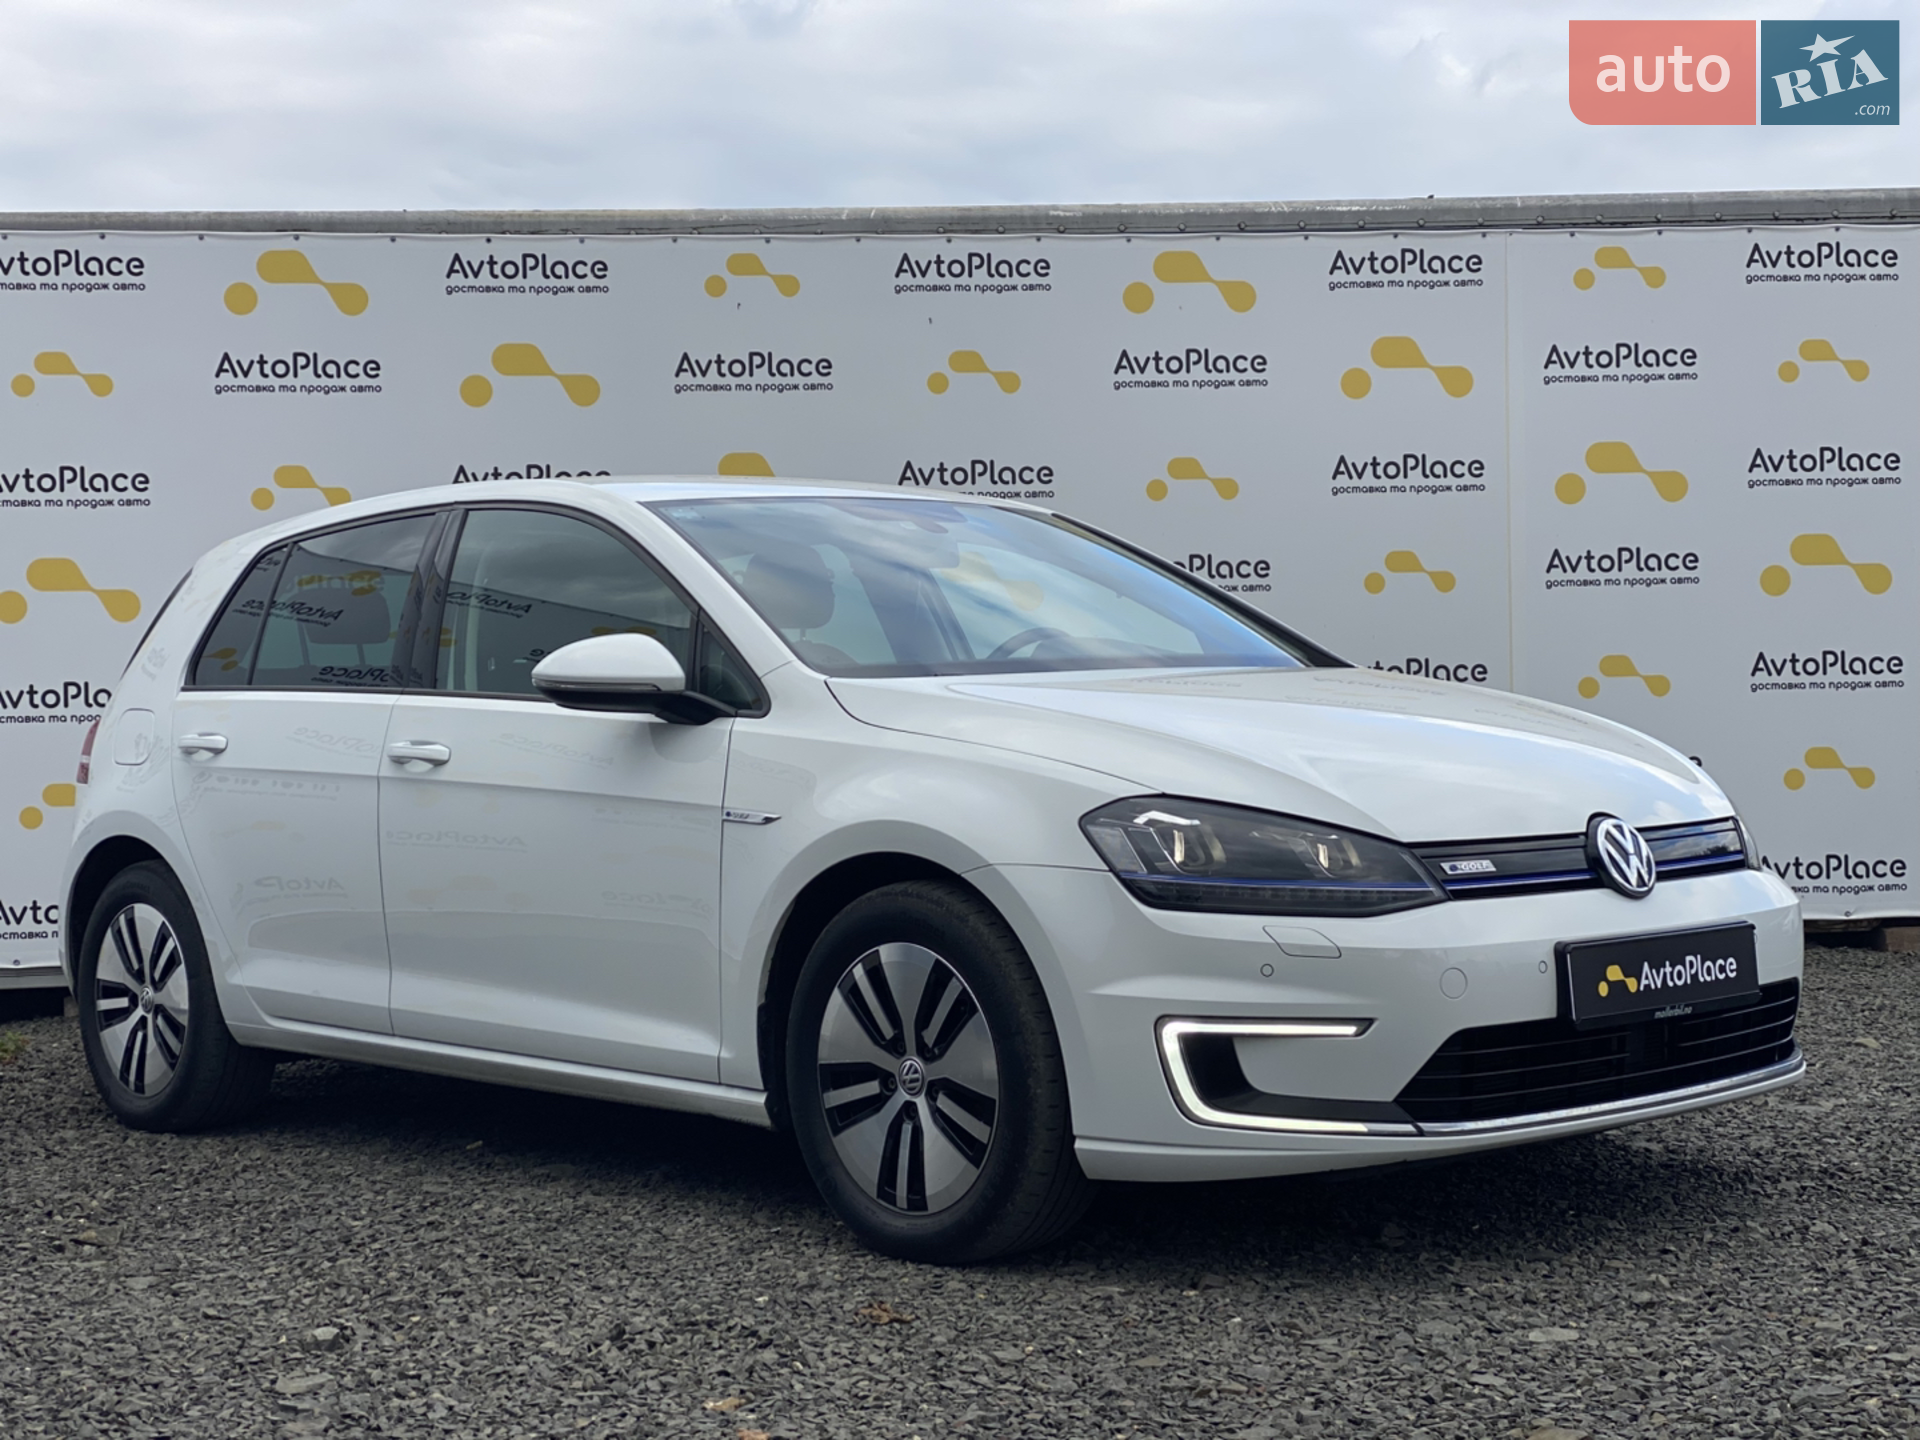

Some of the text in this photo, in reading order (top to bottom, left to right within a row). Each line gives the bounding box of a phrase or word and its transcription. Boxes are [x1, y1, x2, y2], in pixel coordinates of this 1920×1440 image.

[0, 248, 145, 277] vtoPlace
[445, 252, 609, 280] AvtoPlace
[894, 251, 1051, 279] AvtoPlace
[1328, 247, 1483, 276] AvtoPlace
[1745, 240, 1899, 269] AvtoPlace
[0, 282, 36, 291] тавка
[214, 351, 382, 380] AvtoPlace
[674, 351, 833, 379] AvtoPlace
[1113, 347, 1268, 376] AvtoPlace
[1543, 342, 1698, 370] AvtoPlace
[897, 459, 1054, 487] AvtoPlace
[1331, 453, 1485, 481] AvtoPlace
[1747, 446, 1901, 474] AvtoPlace
[0, 465, 151, 494] vtoPlace
[0, 499, 41, 507] тавка
[1173, 553, 1271, 579] Place
[1545, 546, 1700, 575] AvtoPlace
[1367, 657, 1488, 682] Place
[1750, 649, 1904, 678] AvtoPlace
[0, 681, 112, 710] vtoPla
[0, 715, 45, 724] ставка
[0, 931, 48, 940] ставка
[1639, 954, 1738, 991] AvtoPlace
